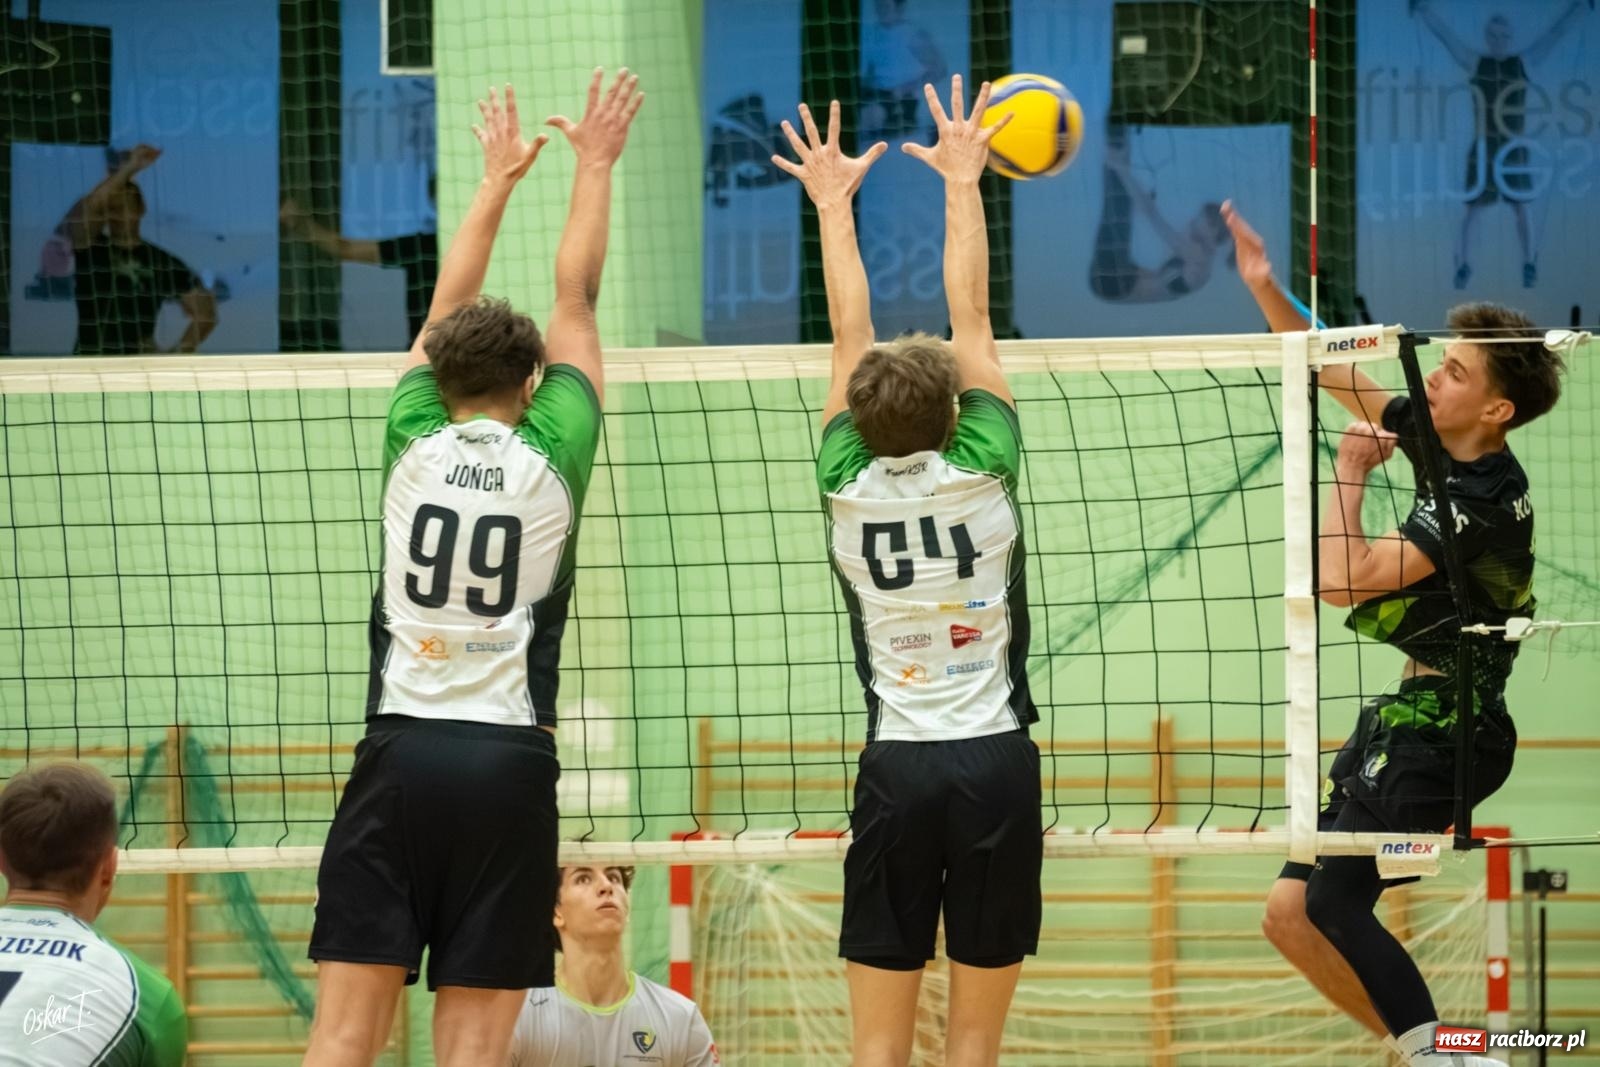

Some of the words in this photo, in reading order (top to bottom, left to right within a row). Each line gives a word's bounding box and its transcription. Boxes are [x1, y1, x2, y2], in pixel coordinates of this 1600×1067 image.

[1357, 66, 1600, 143] fitnes
[1326, 336, 1379, 352] netex
[445, 462, 504, 492] JOŃCA
[404, 503, 522, 617] 99
[890, 632, 932, 647] PIVEXIN
[1381, 841, 1435, 854] netex
[0, 935, 87, 962] ZCZOK
